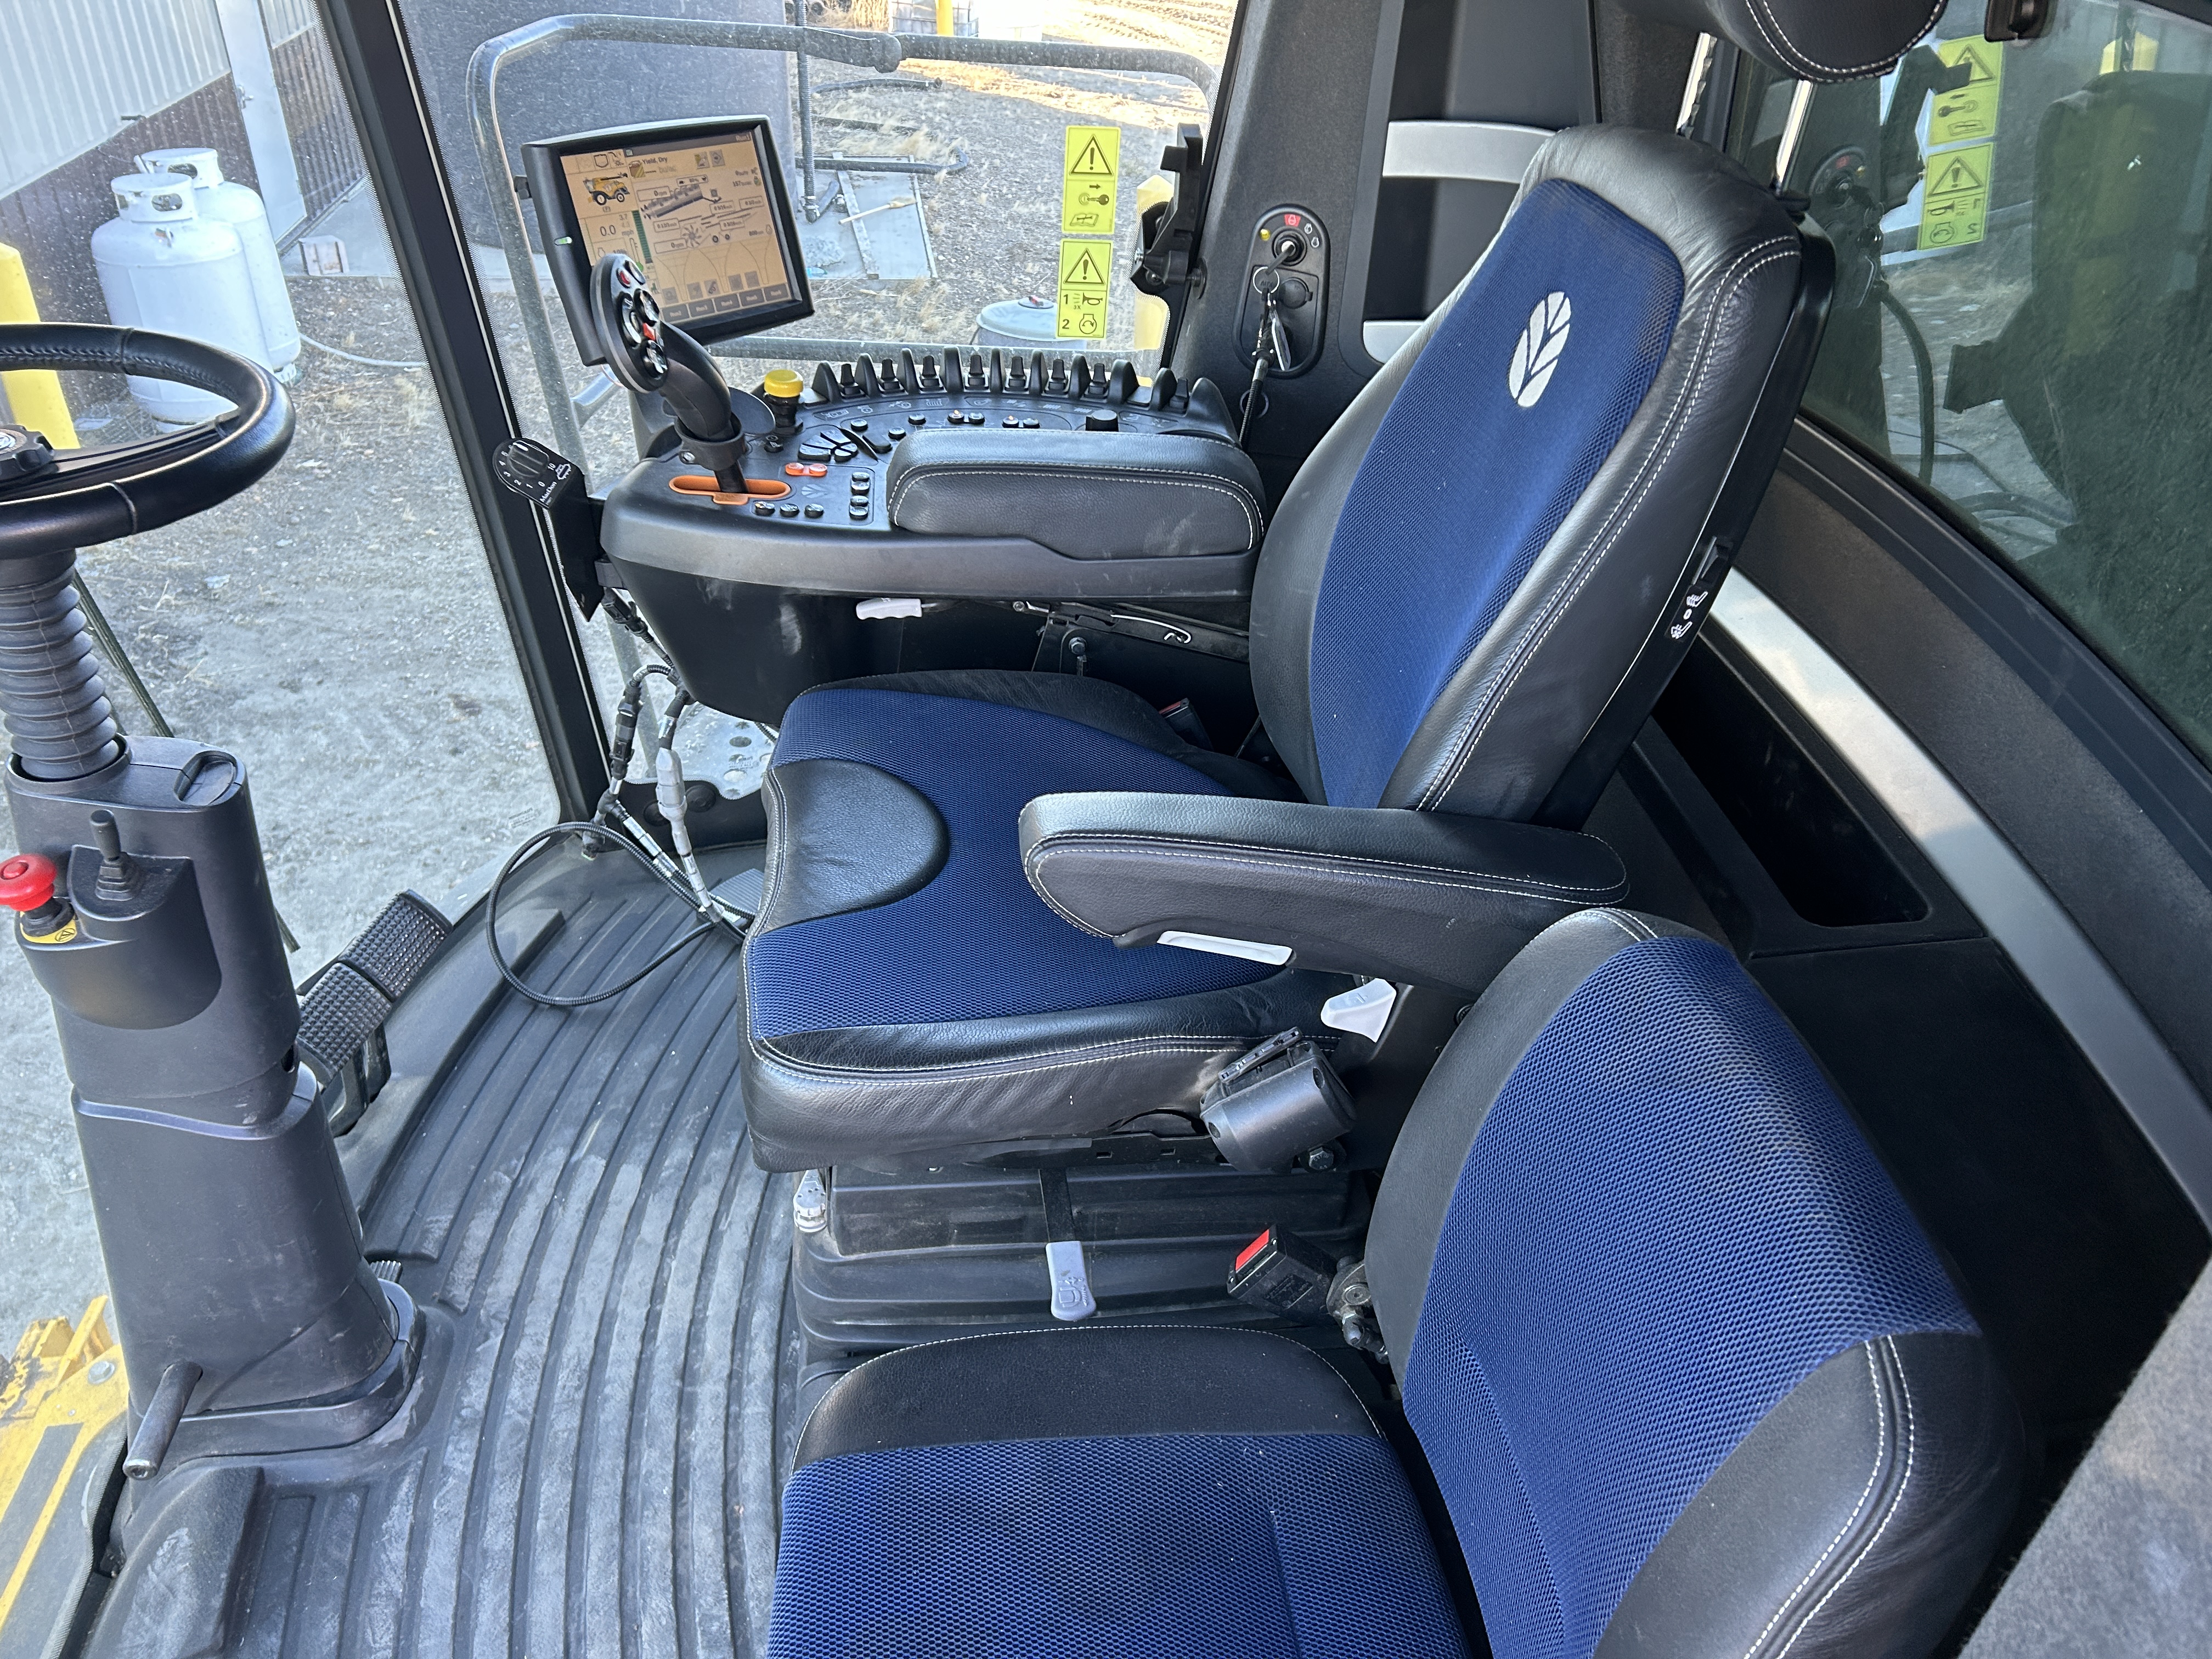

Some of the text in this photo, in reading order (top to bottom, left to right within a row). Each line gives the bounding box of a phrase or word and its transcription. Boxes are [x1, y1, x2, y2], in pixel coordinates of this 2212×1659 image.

[600, 224, 616, 236] 0.0
[1063, 294, 1069, 304] 1
[1062, 319, 1070, 329] 2
[548, 462, 556, 471] 10
[539, 481, 557, 503] MacDon
